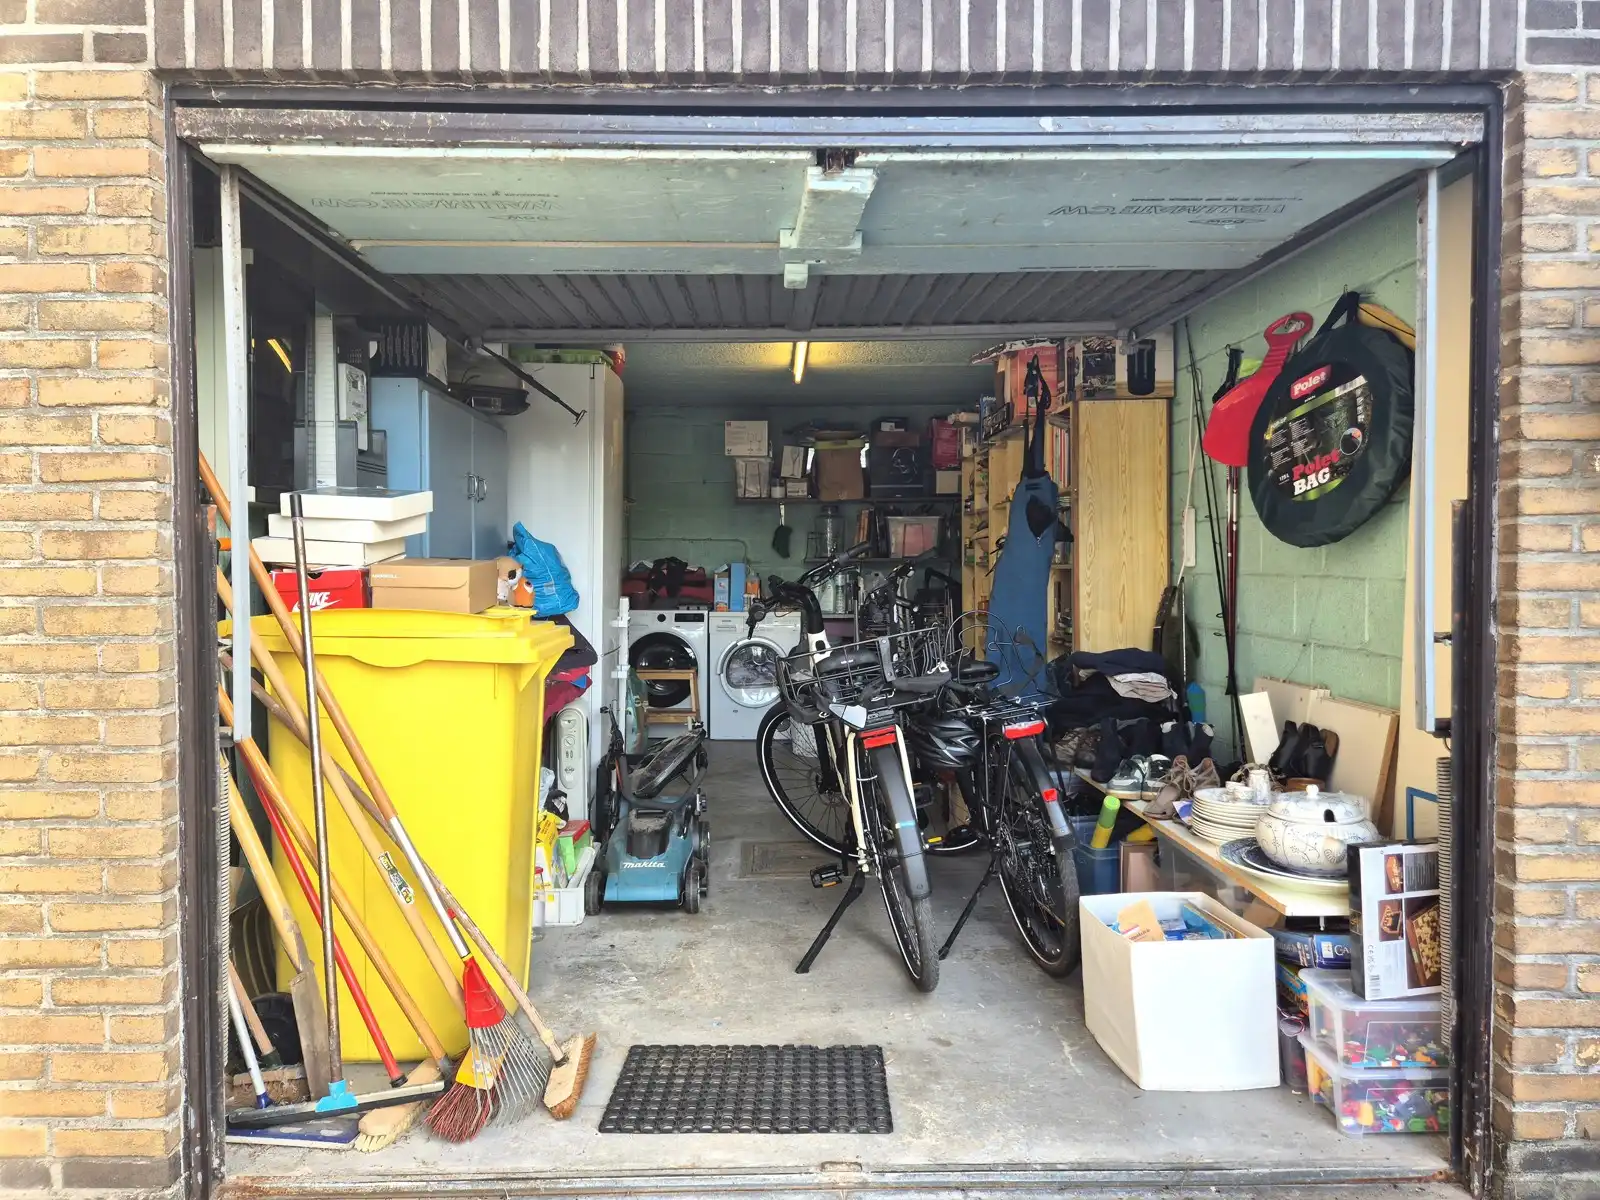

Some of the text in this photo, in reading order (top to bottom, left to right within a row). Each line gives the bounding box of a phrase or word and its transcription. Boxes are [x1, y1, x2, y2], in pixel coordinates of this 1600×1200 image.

[1293, 372, 1327, 396] Polet
[1292, 448, 1341, 480] Polet
[1293, 468, 1331, 495] BAG
[623, 861, 666, 869] makita
[1334, 944, 1351, 956] CA
